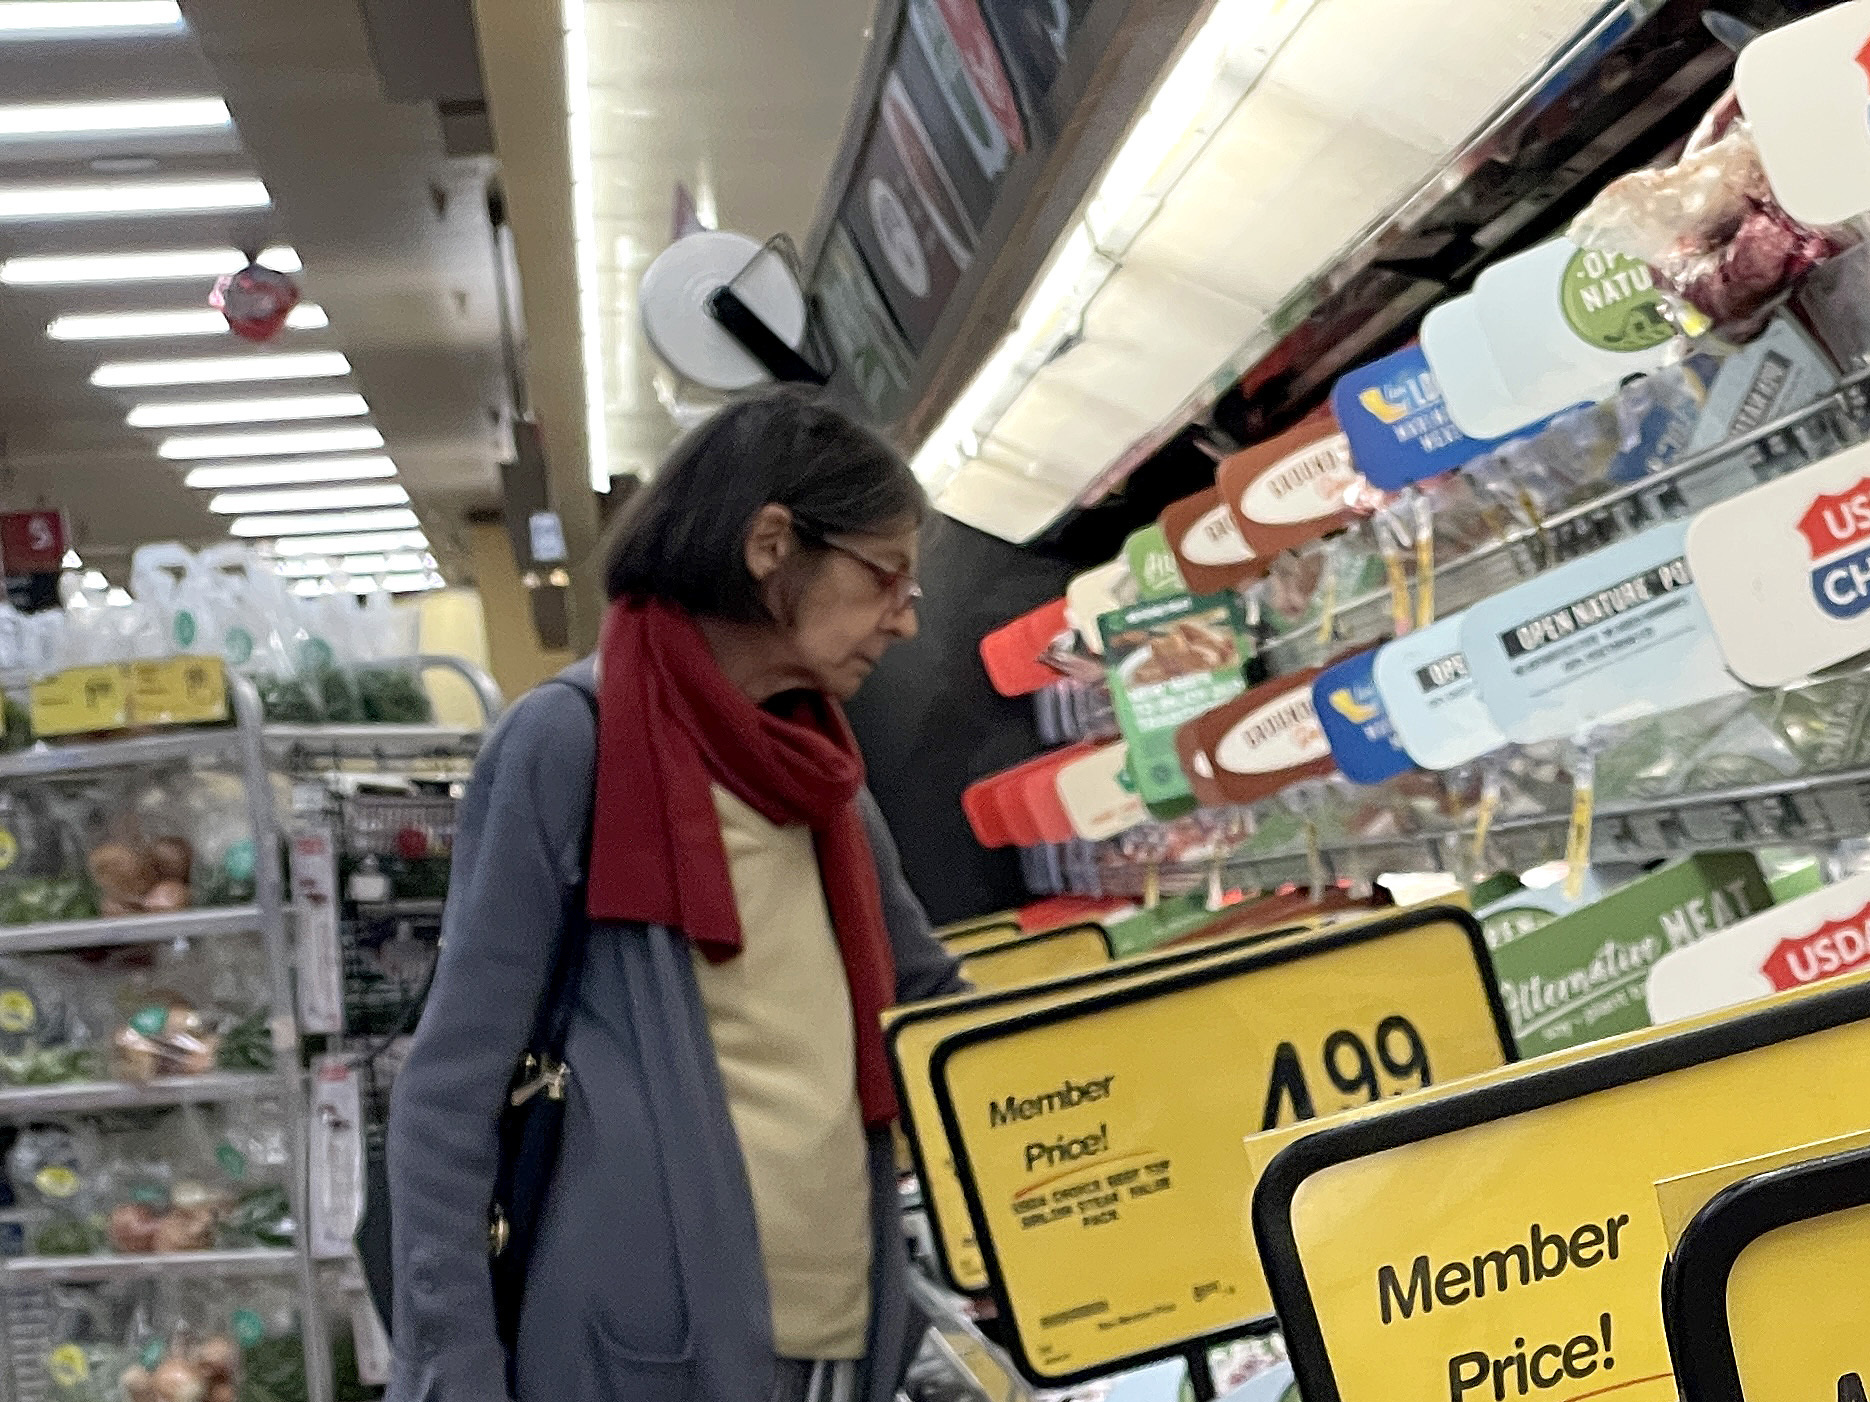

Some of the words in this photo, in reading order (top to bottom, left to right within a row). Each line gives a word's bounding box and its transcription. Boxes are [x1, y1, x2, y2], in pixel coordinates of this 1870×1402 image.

[1580, 264, 1654, 312] NATU
[1659, 878, 1750, 949] MEAT
[989, 1075, 1115, 1129] Member
[1025, 1121, 1108, 1172] Price!
[1377, 1212, 1630, 1326] Member
